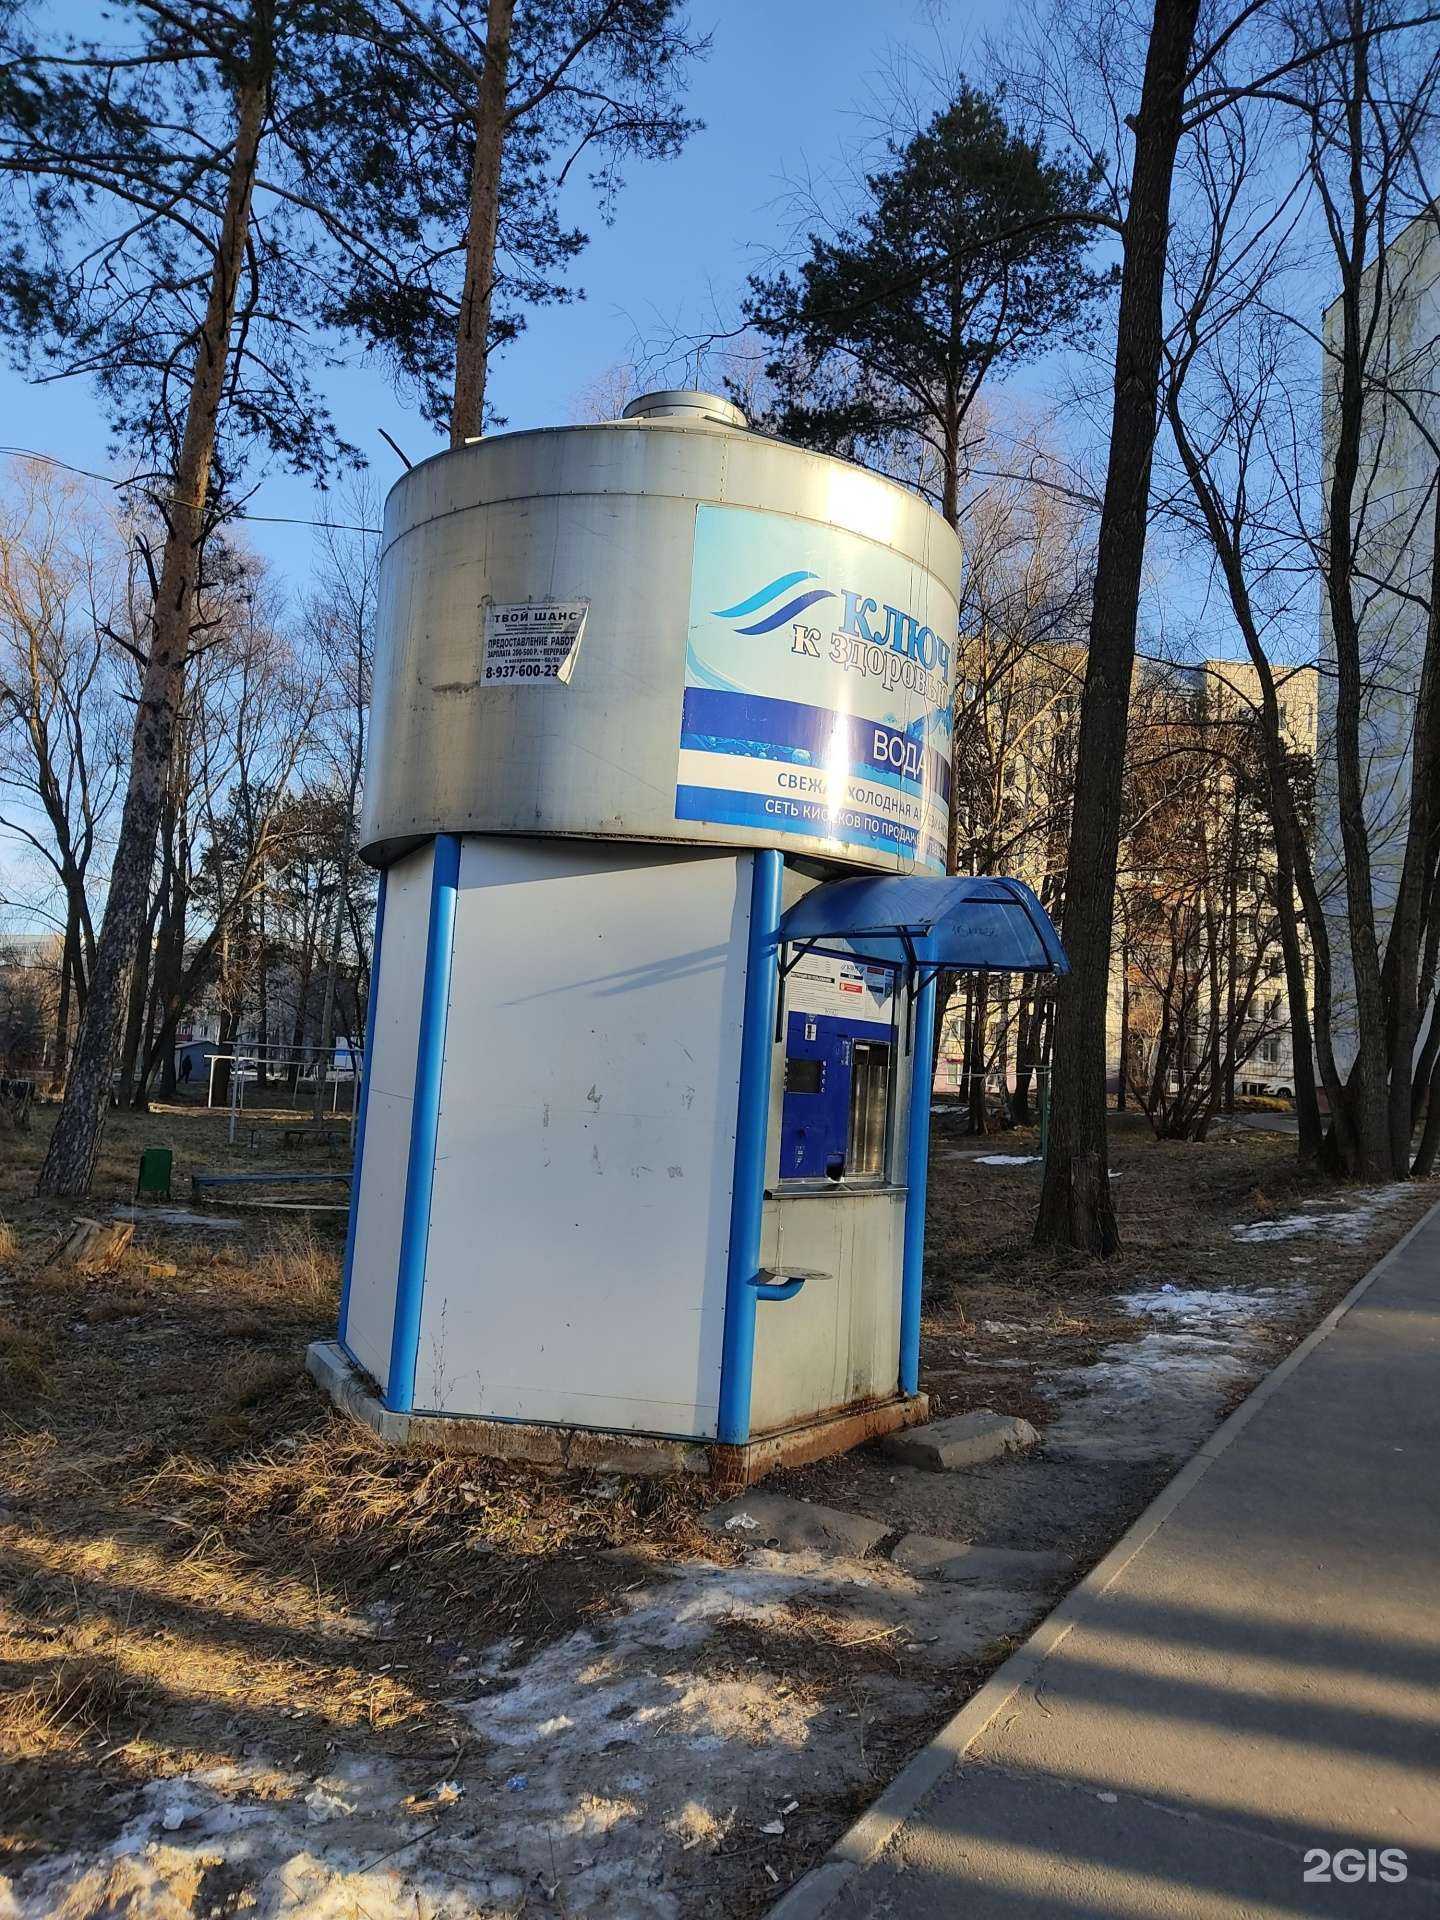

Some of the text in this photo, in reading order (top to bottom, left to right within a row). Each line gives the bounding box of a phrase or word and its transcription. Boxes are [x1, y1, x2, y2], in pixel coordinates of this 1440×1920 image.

[495, 611, 577, 623] ТВОЙ ШАНС
[487, 637, 575, 649] ПРЕДОСТАВЛЕНИЕ РАБОТ
[838, 589, 950, 682] КЛЮЧ
[777, 772, 833, 796] СВЕЖ
[765, 799, 799, 817] СЕТЬ
[803, 805, 861, 828] КИОКОВ
[864, 817, 880, 833] ПО
